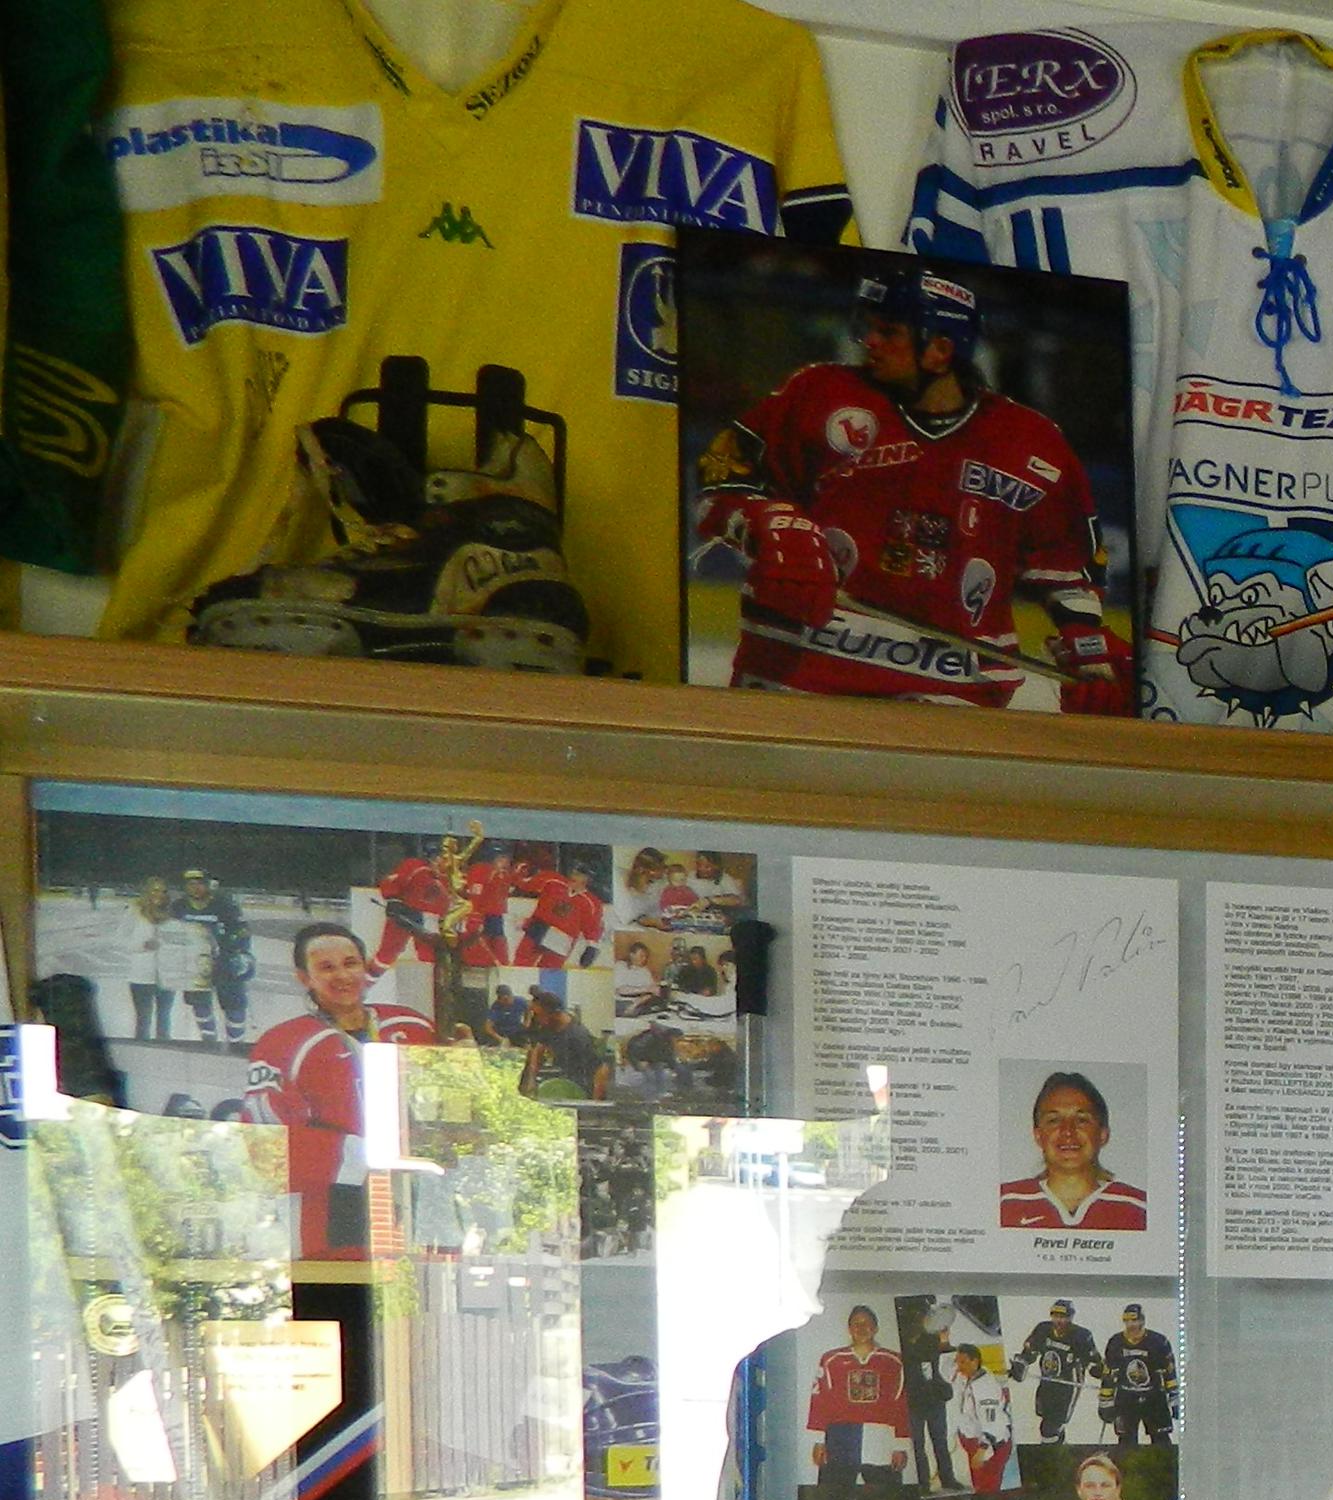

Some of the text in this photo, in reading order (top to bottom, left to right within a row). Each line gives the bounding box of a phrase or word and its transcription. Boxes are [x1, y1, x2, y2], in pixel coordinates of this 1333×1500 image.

[104, 116, 280, 161] plastika
[585, 125, 768, 236] VIVA
[159, 229, 343, 312] VIVA
[808, 617, 973, 679] EuroTel
[1033, 1236, 1116, 1251] Pavel Patera
